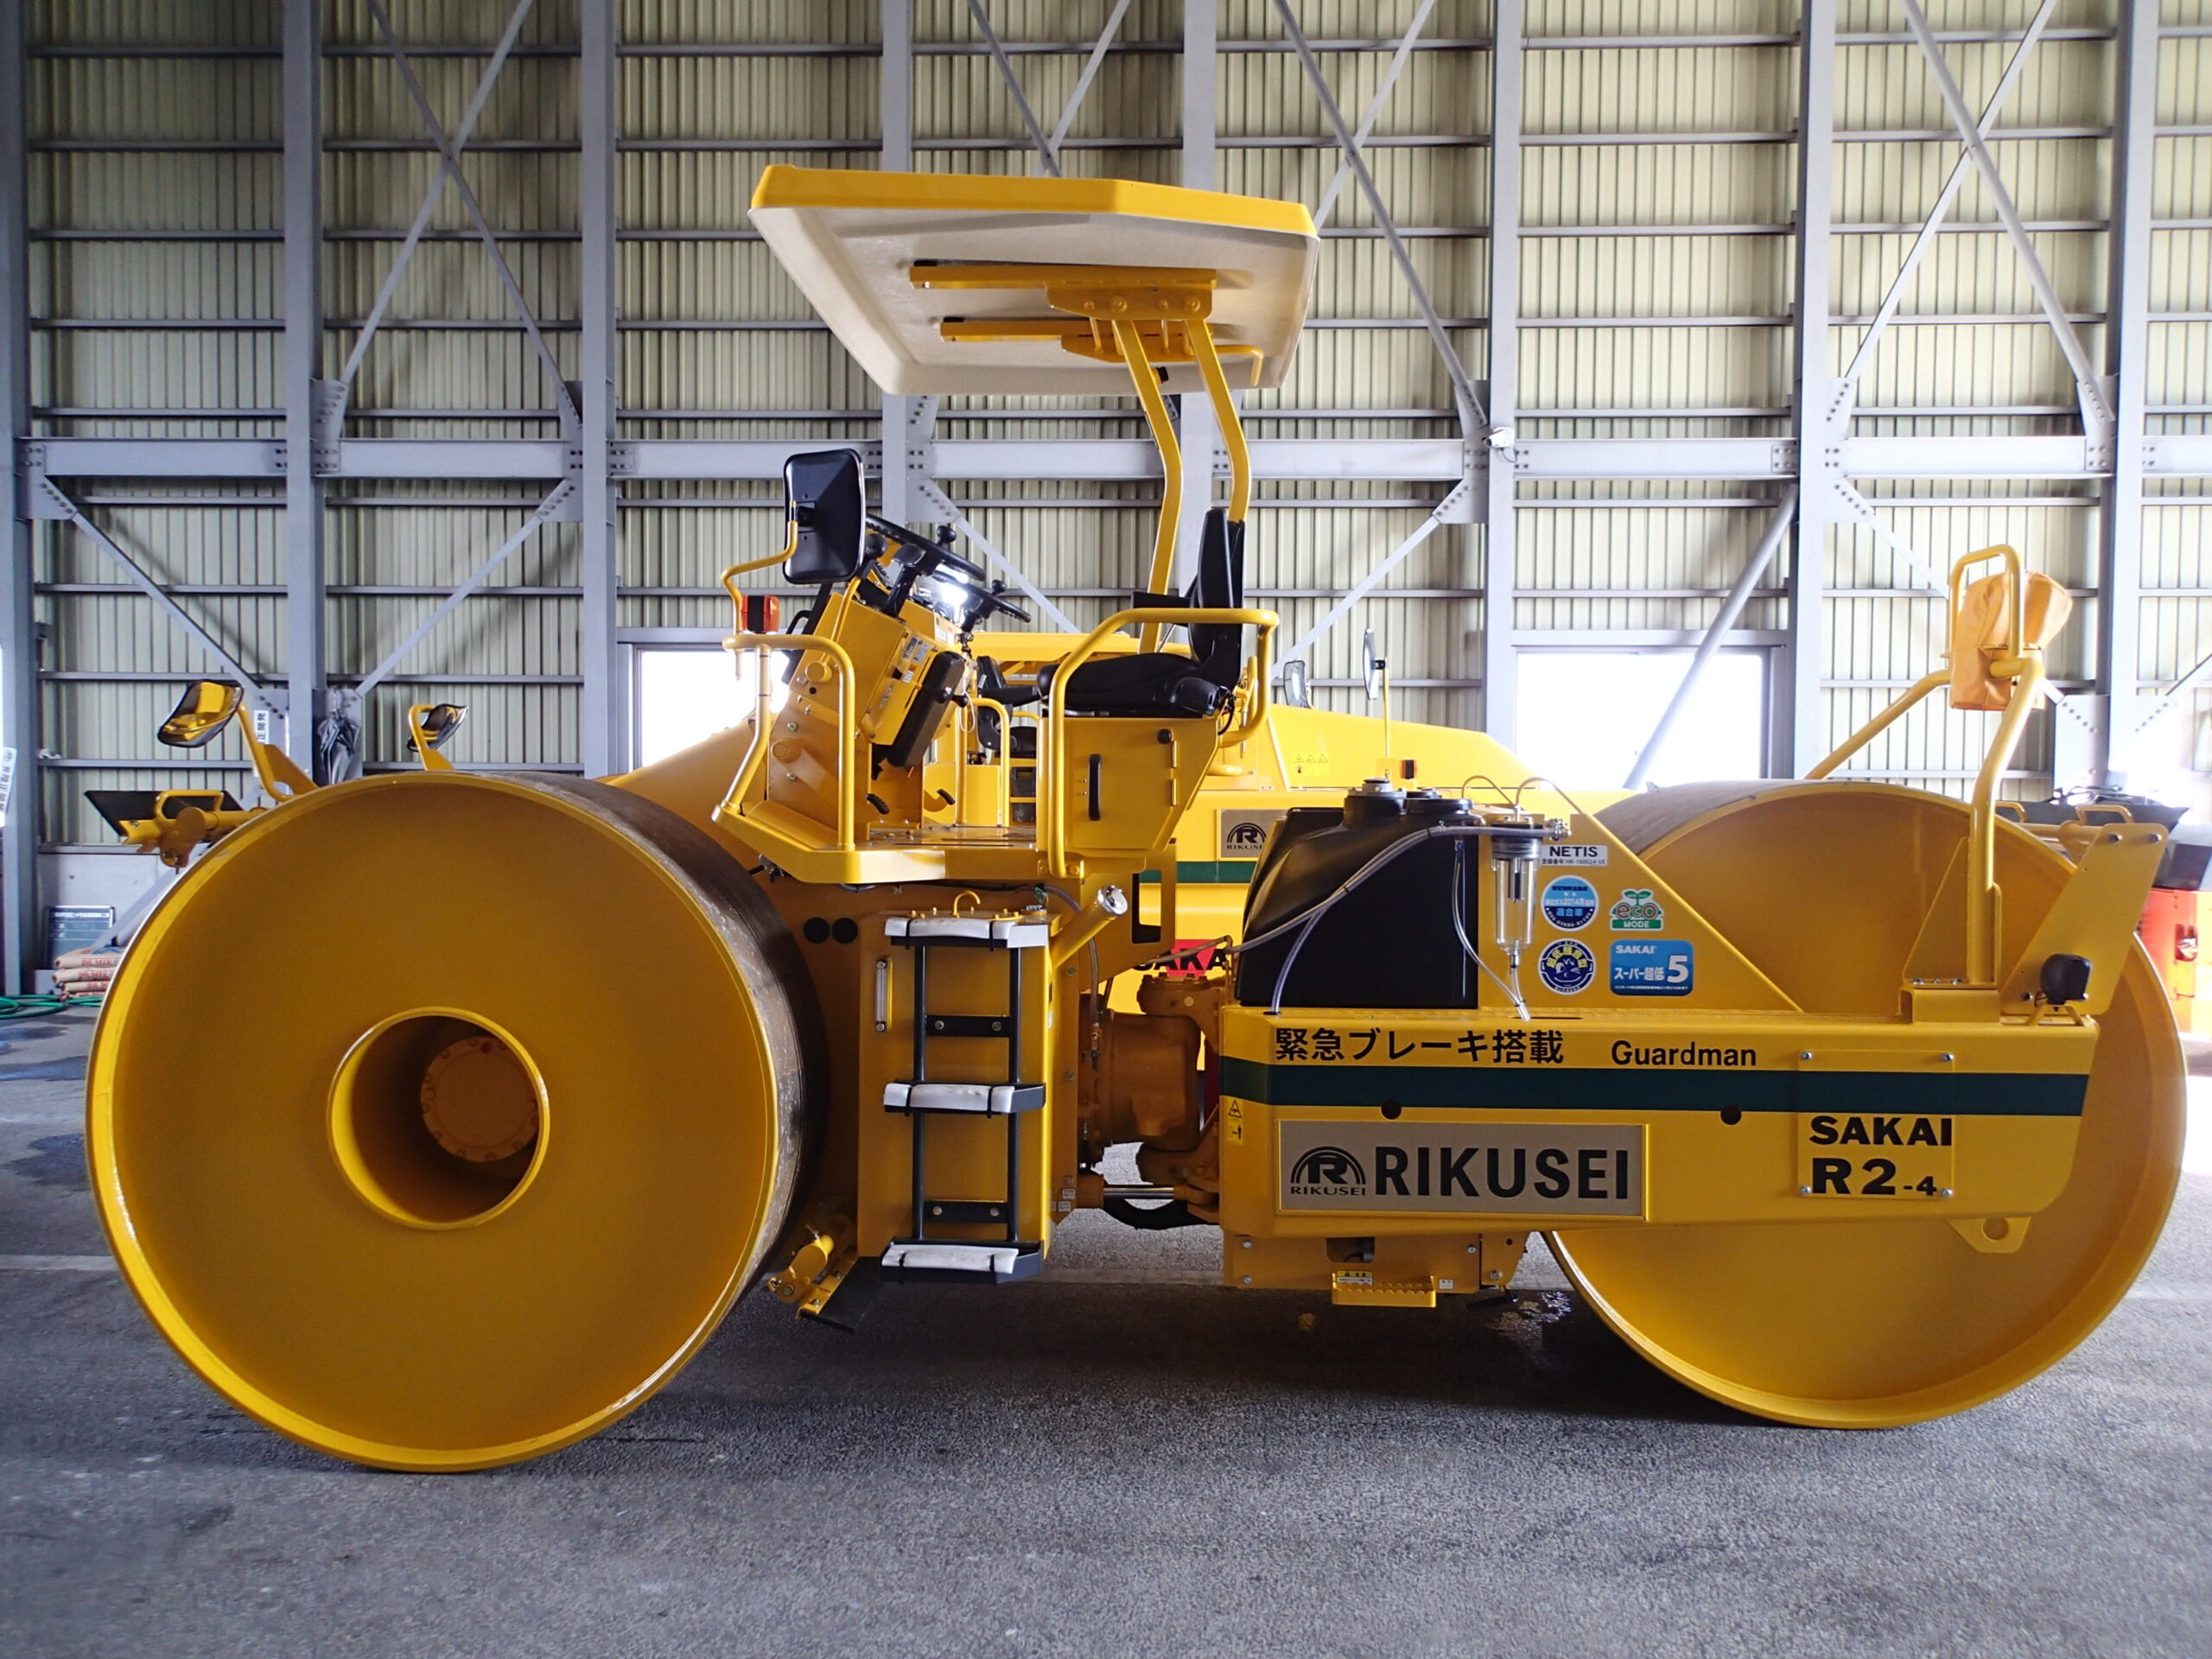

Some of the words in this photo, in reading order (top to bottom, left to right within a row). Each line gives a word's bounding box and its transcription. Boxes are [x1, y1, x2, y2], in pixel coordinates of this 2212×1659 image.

[1549, 846, 1598, 857] NETIS
[1617, 904, 1657, 918] eco
[1616, 945, 1656, 954] SAKAI
[1614, 967, 1665, 982] スーパー超低
[1667, 955, 1689, 983] 5
[1275, 1027, 1564, 1065] 緊急ブレーキ搭載
[1611, 1039, 1757, 1067] Guardman
[1809, 1116, 1952, 1147] SAKAI
[1375, 1147, 1629, 1200] RIKUSEI
[1290, 1186, 1366, 1196] RIKUSEI
